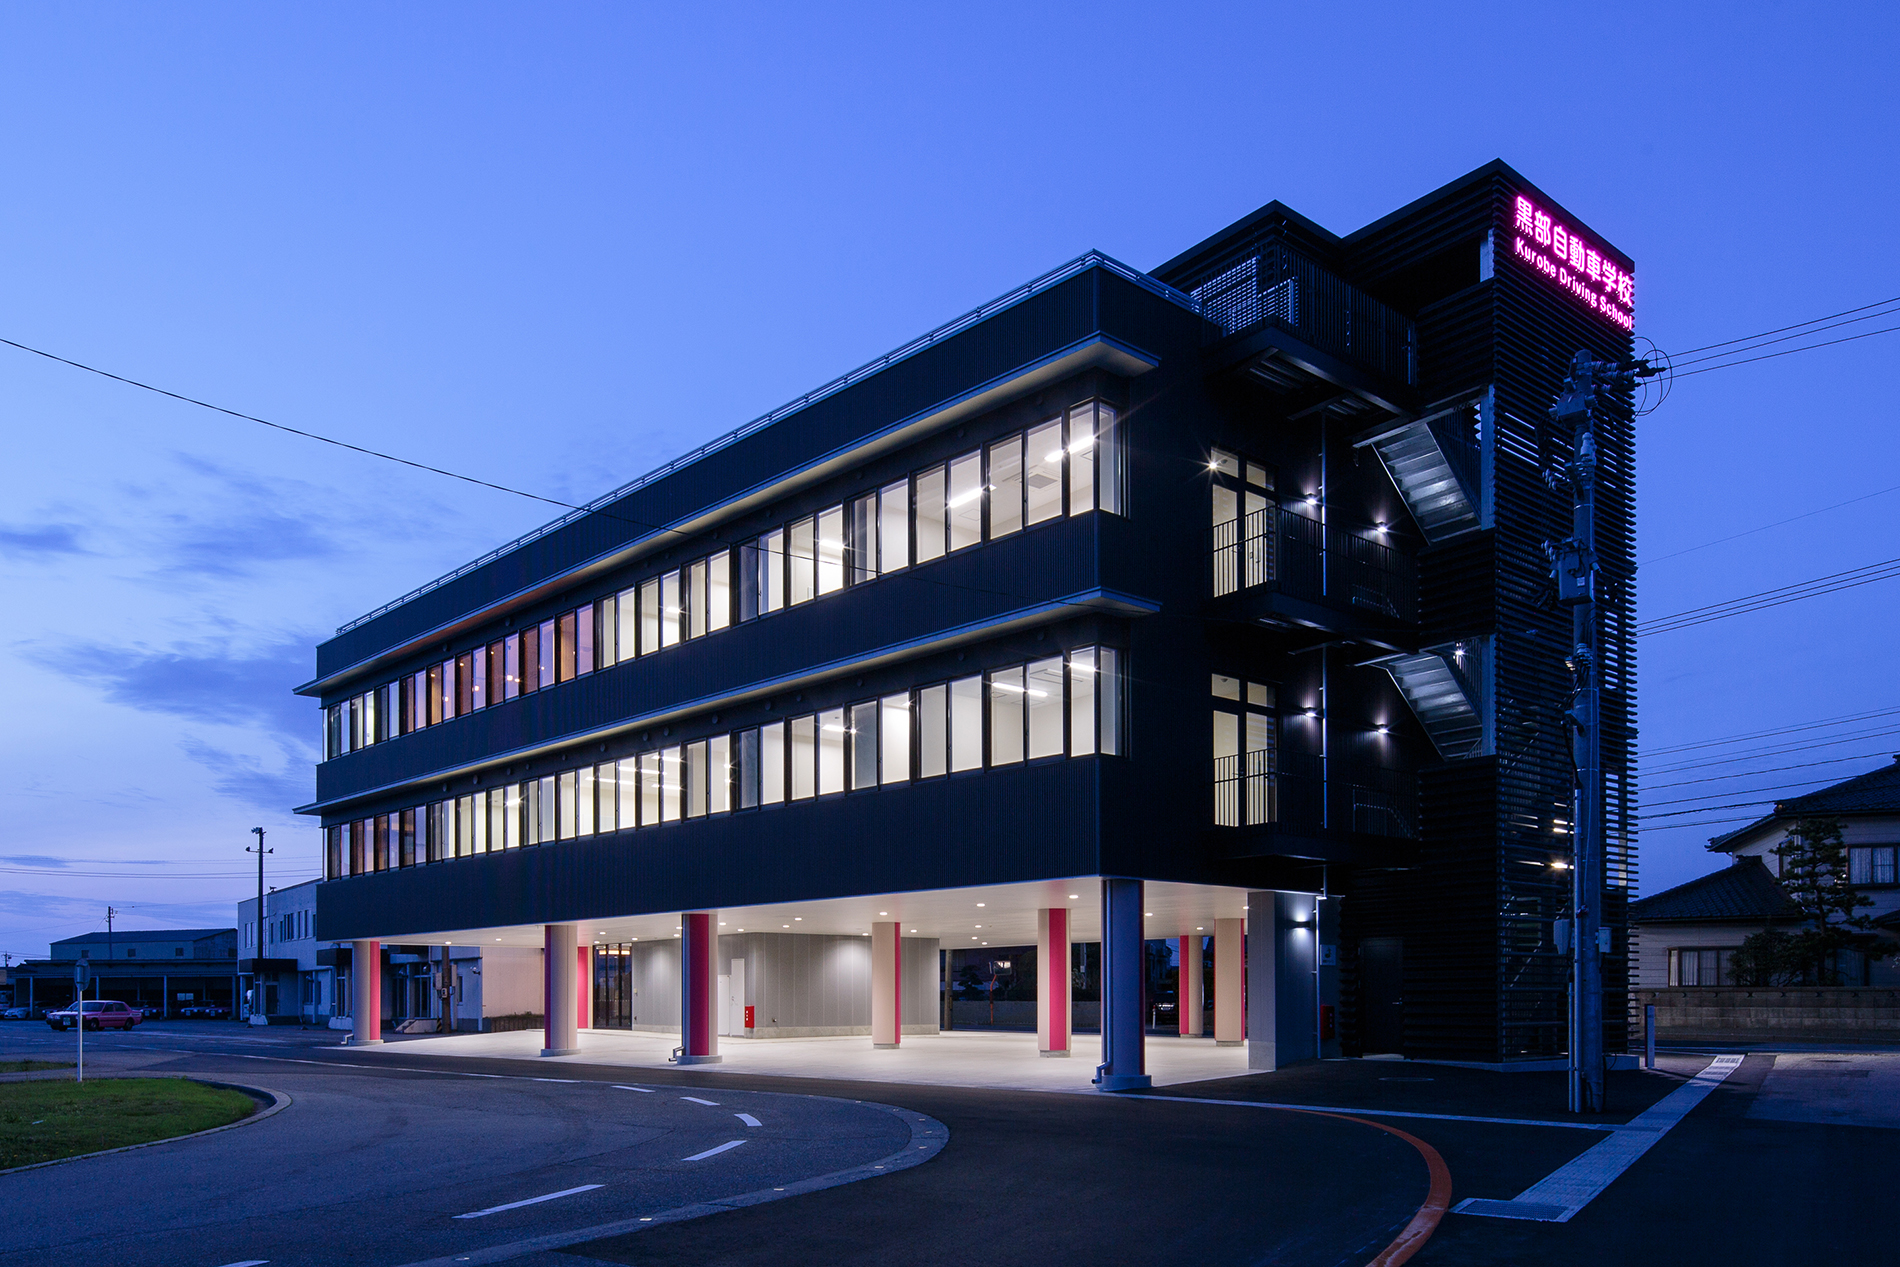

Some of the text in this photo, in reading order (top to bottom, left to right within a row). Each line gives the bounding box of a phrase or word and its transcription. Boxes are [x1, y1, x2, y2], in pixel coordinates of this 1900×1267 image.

[1516, 196, 1633, 308] 黒部自動車学校
[1516, 237, 1633, 330] Kurobe Driving School
